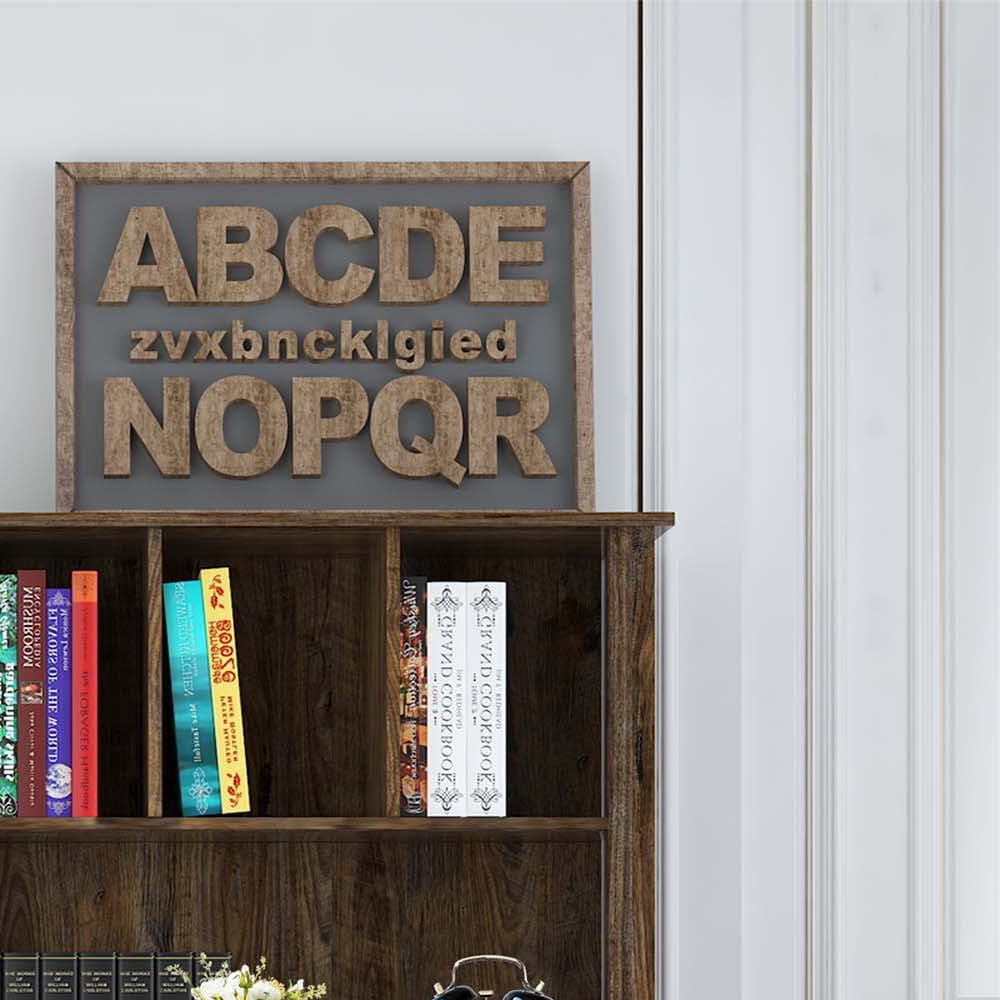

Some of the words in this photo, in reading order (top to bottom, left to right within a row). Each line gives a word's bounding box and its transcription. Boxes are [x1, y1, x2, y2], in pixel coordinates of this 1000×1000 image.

[98, 204, 548, 306] ABCDE
[129, 320, 517, 370] zvxbncklgied
[103, 376, 557, 487] NOPQR
